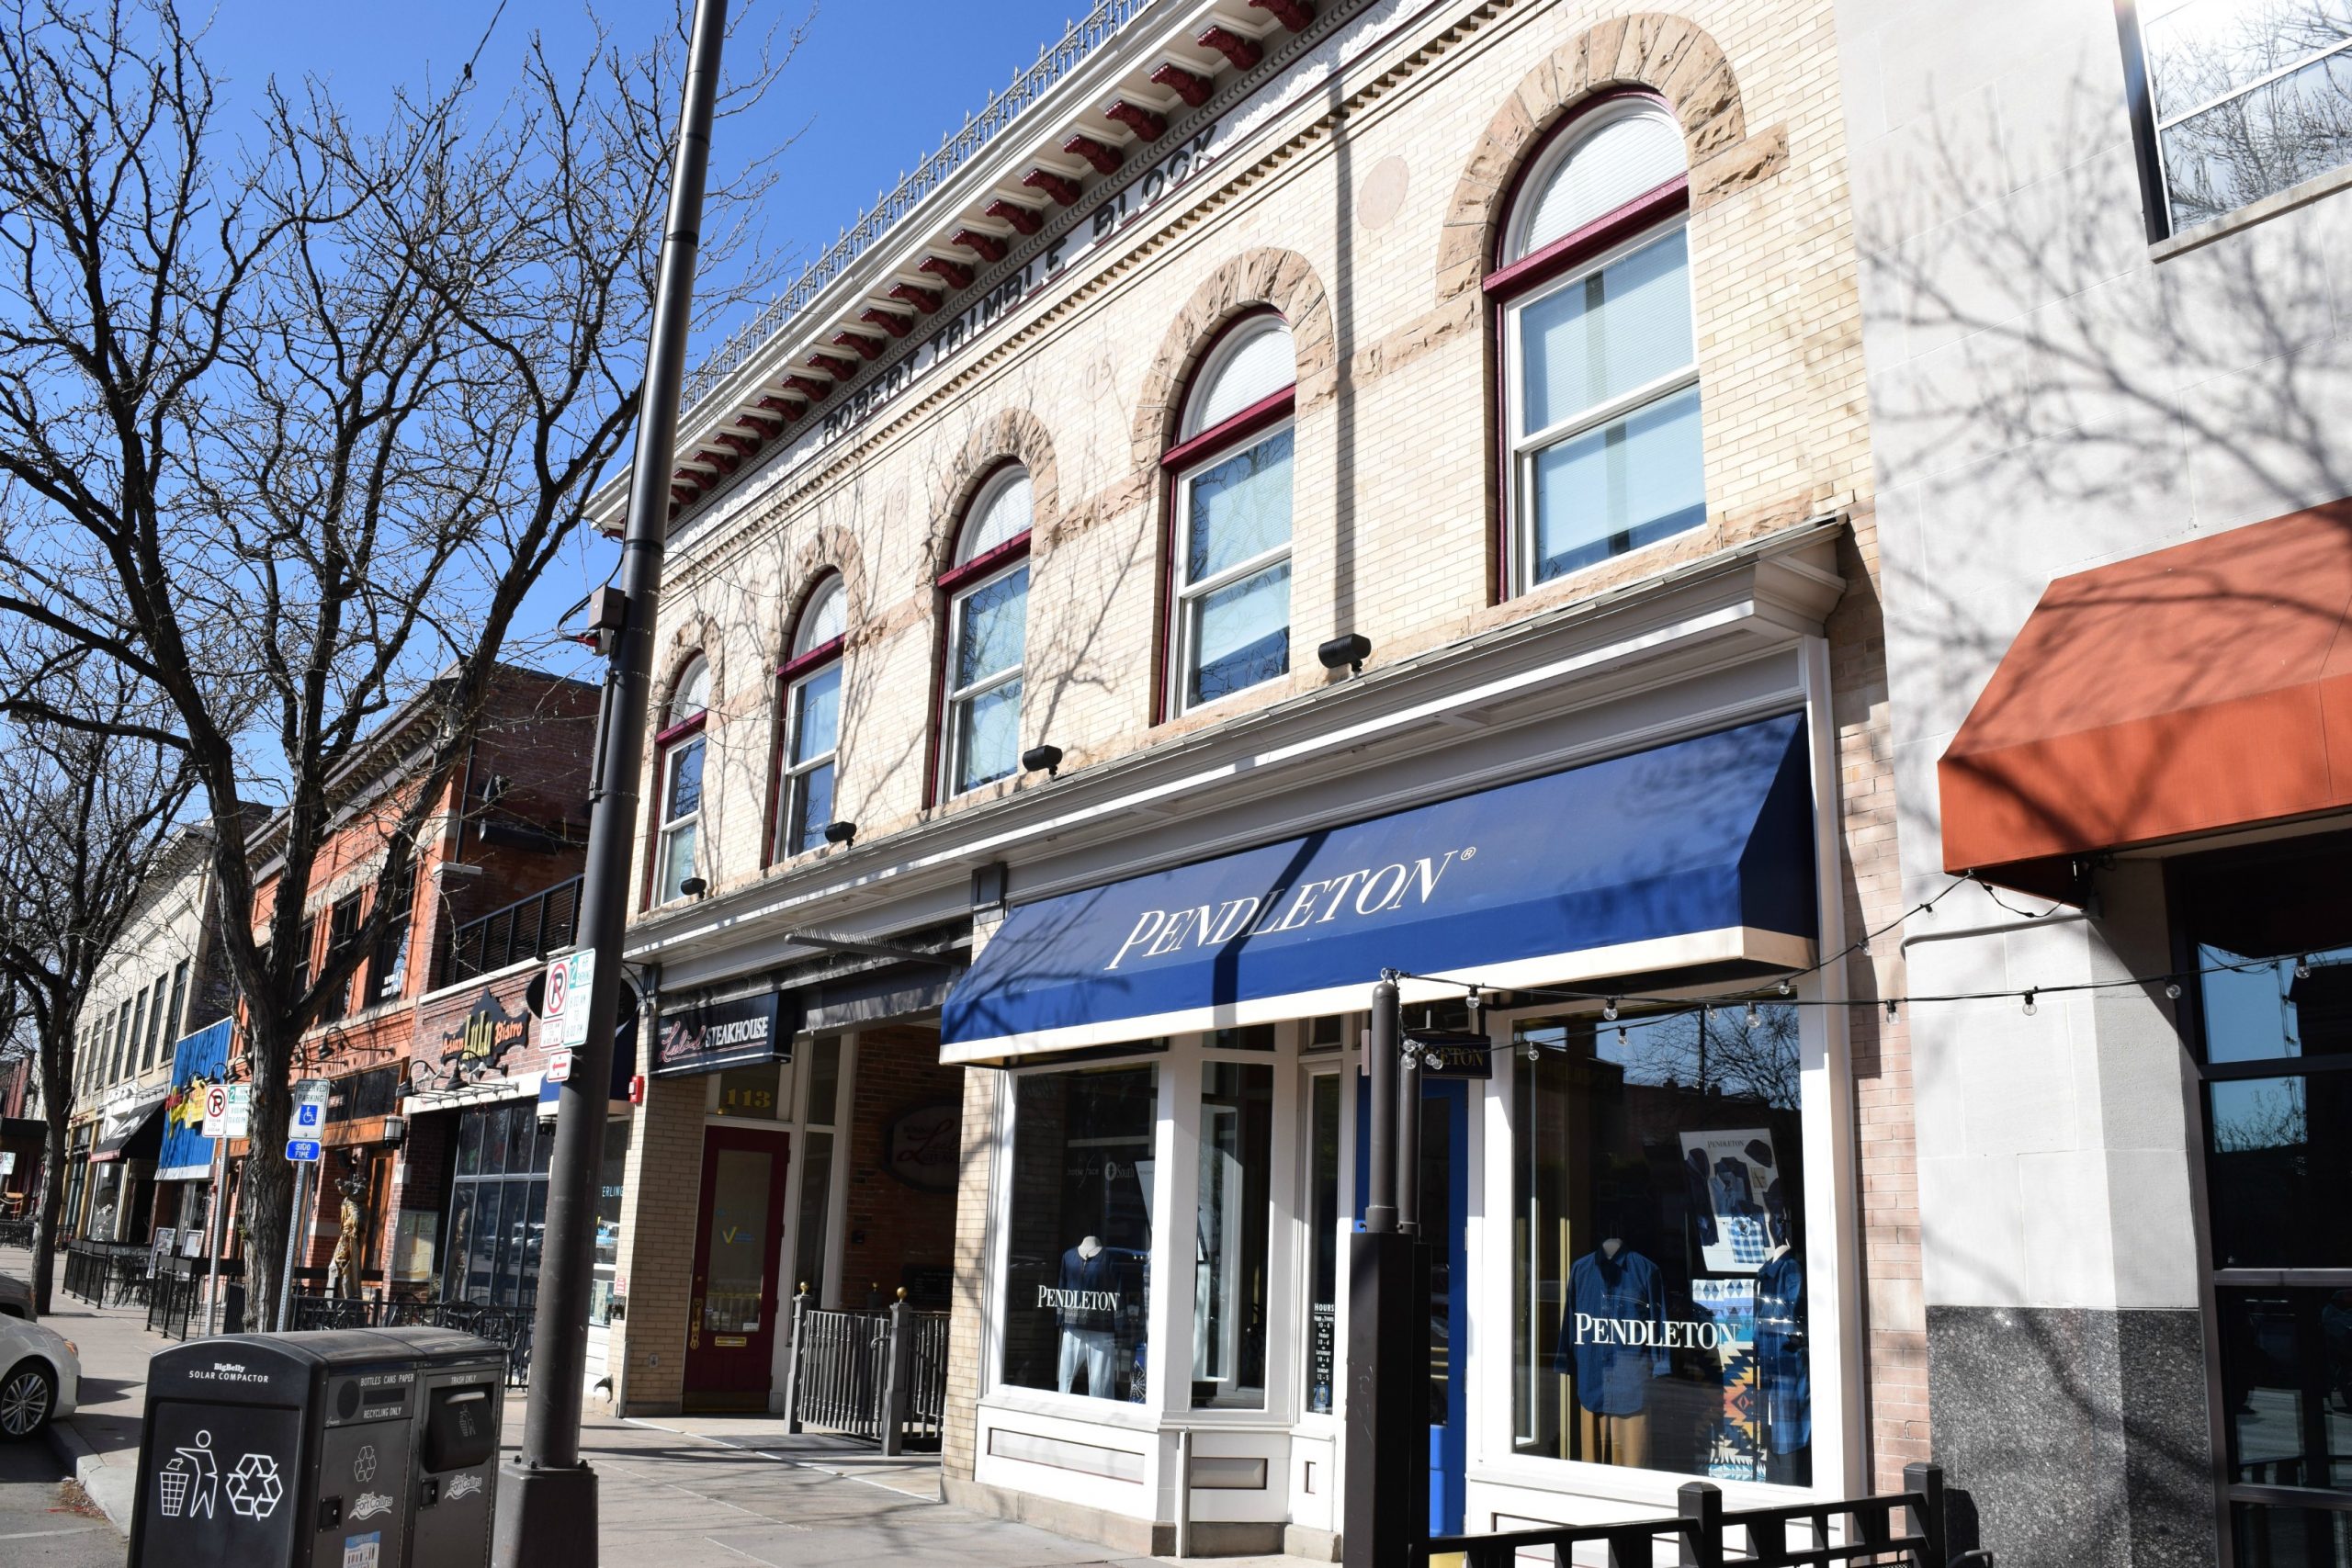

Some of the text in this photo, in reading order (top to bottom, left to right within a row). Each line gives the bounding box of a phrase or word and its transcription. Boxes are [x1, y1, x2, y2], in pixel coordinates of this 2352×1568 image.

[822, 125, 1217, 446] ROBERT TRIMBLE BLOCK
[495, 1020, 523, 1046] Bistro
[705, 1016, 769, 1048] STEAKHOUSE
[298, 1084, 327, 1092] RESERVED
[298, 1094, 324, 1102] PARKING
[727, 1088, 771, 1108] 113
[1036, 1284, 1120, 1312] PENDLETON
[1314, 1303, 1335, 1312] HOURS
[1574, 1313, 1737, 1349] PENDLETON
[214, 1362, 246, 1373] BigBelly
[188, 1370, 269, 1383] SOLAR COMPACTOR
[360, 1373, 414, 1387] BOTTLES CANS PAPER
[363, 1406, 401, 1419] RECYCLING ONLY
[370, 1495, 393, 1508] Collins
